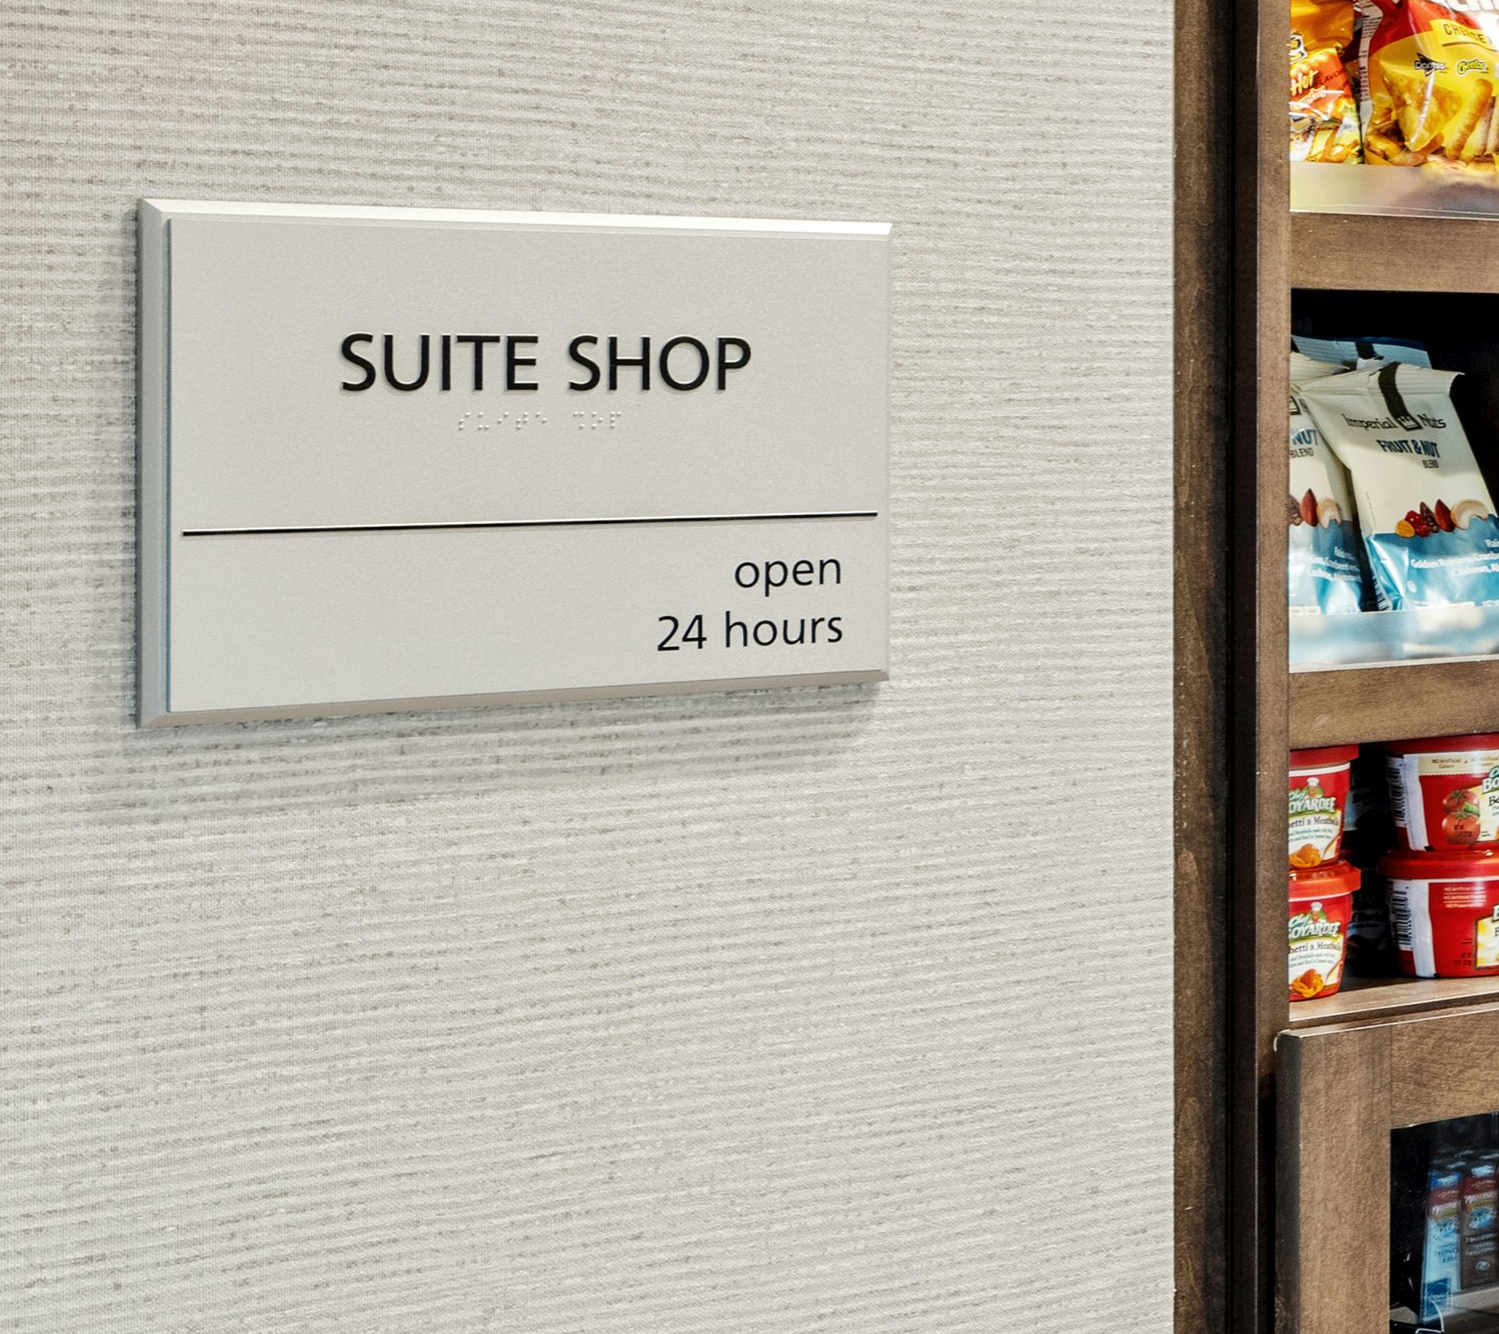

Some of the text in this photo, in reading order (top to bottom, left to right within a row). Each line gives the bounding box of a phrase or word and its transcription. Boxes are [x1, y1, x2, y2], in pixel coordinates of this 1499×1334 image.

[339, 332, 752, 393] SUITE SHOP
[1341, 413, 1447, 431] Imperial Nuts
[1292, 428, 1319, 446] NUT
[1376, 439, 1440, 458] FRUIT & NUT
[1422, 459, 1440, 469] BLEND
[734, 554, 841, 597] open
[656, 610, 843, 652] 24 hours
